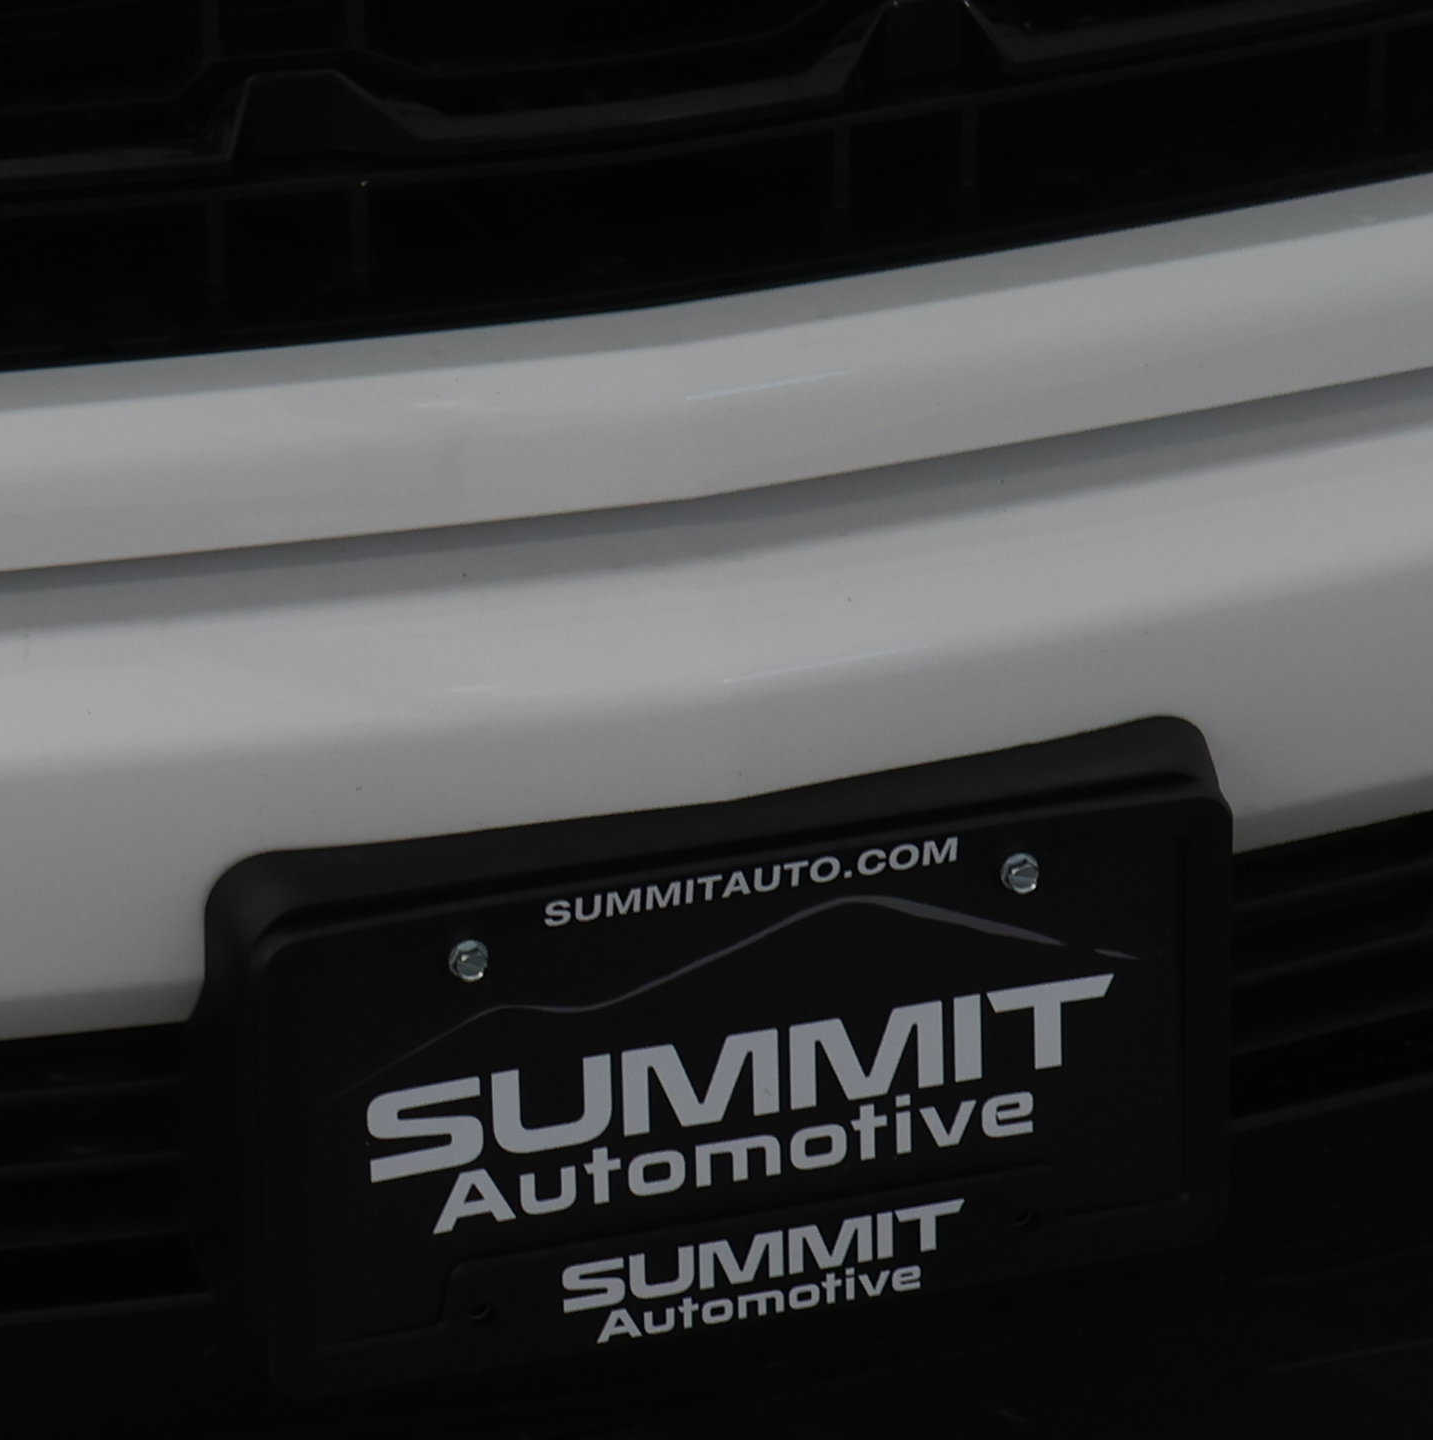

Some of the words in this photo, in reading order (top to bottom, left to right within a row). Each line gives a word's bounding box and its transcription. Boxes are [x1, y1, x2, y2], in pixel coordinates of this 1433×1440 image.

[543, 836, 960, 928] SUMMITAUTO.COM
[366, 972, 1115, 1184] SUMMIT
[432, 1091, 1035, 1236] Automotive
[561, 1197, 965, 1314] SUMMIT
[597, 1262, 923, 1344] Automotive
